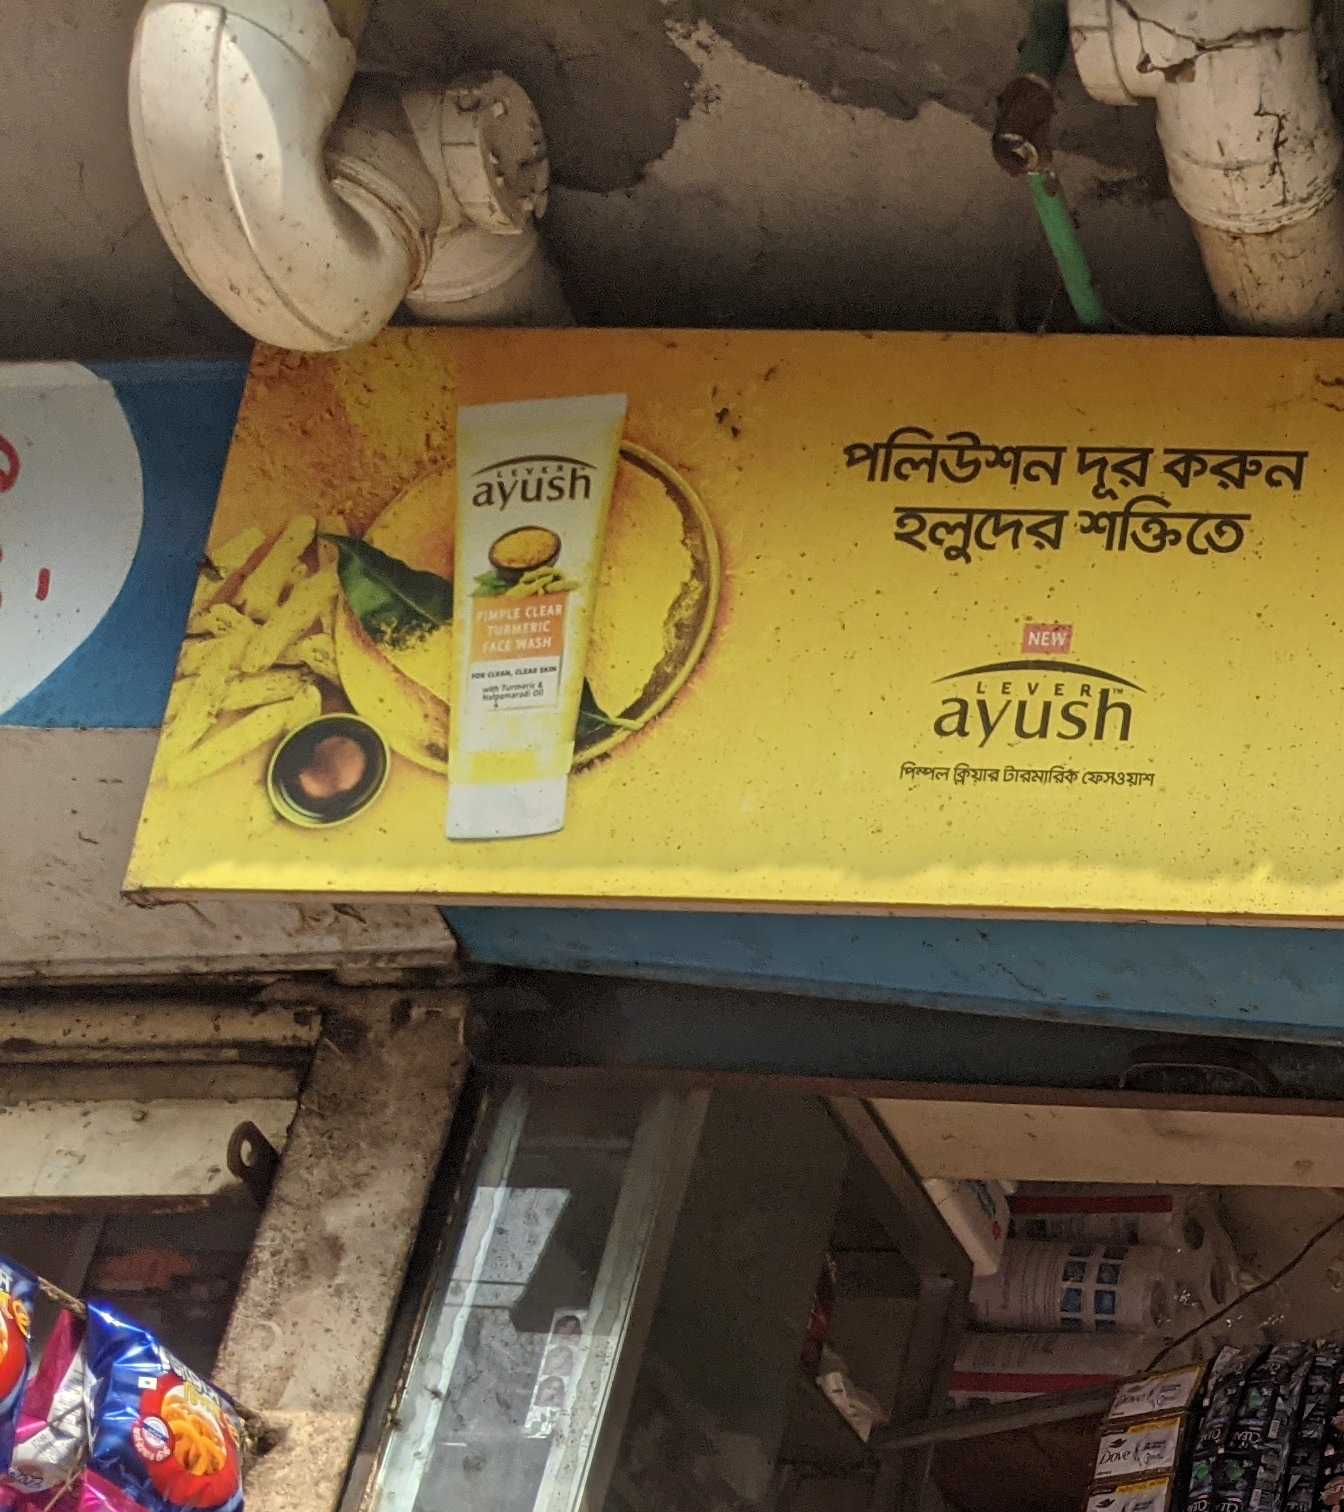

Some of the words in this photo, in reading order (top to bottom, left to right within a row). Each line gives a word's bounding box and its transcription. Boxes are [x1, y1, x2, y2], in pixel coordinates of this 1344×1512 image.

[843, 426, 1067, 486] পলিউশন
[1076, 446, 1154, 499] দূর
[1163, 447, 1309, 491] করুন
[471, 467, 591, 511] ayush
[893, 507, 1069, 564] হলুদের
[1078, 498, 1251, 555] শক্তিতে
[1027, 630, 1067, 648] NEW
[976, 682, 1092, 698] LEVER
[933, 690, 1133, 748] ayush
